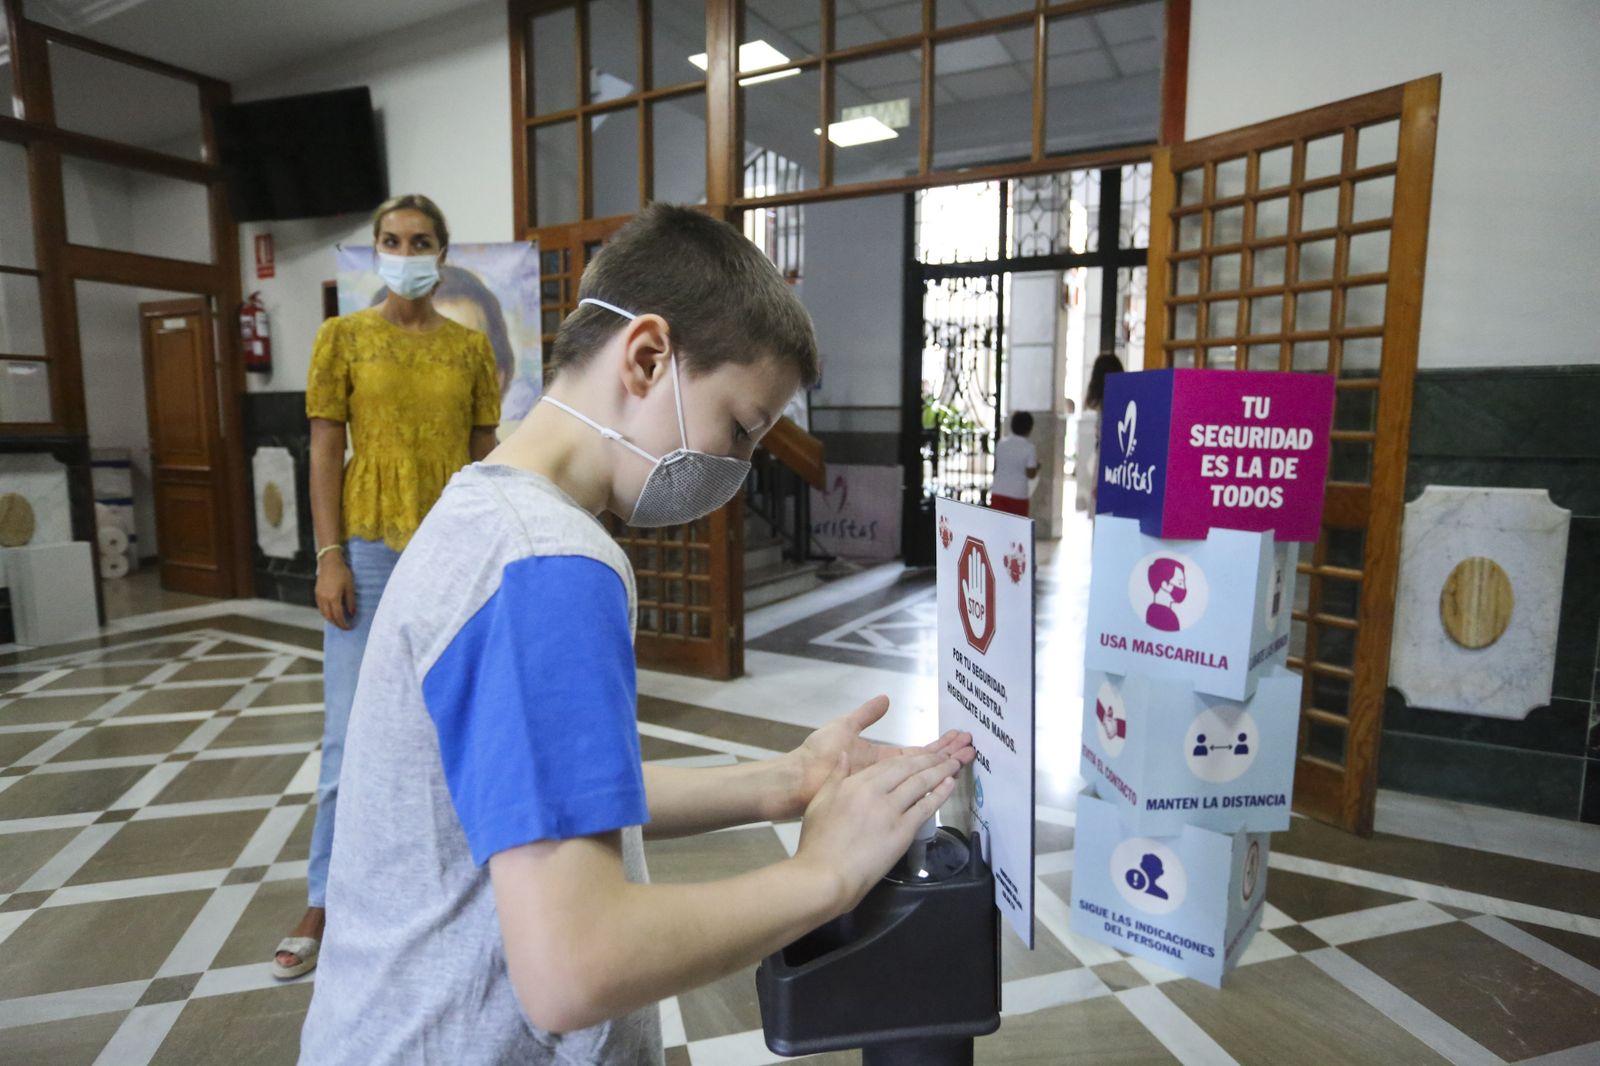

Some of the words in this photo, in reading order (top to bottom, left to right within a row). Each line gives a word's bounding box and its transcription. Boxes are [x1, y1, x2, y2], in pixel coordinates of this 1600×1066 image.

[1242, 396, 1270, 419] TU
[1189, 424, 1313, 451] SEGURIDAD
[1104, 460, 1156, 494] maristas
[1201, 454, 1229, 478] ES
[1235, 456, 1263, 479] LA
[1269, 457, 1299, 480] DE
[1210, 484, 1284, 508] TODOS
[813, 518, 878, 540] aristas
[968, 597, 985, 620] STOP
[953, 647, 963, 664] POR
[964, 656, 971, 670] TU
[1100, 633, 1127, 650] USA
[1132, 639, 1229, 670] MASCARILLA
[955, 669, 966, 687] POR
[967, 678, 974, 694] LA
[947, 681, 978, 719] HIGIENIZATE
[979, 710, 990, 730] LAS
[1105, 766, 1137, 805] CONTACTO
[1146, 797, 1199, 811] MANTEN
[1203, 797, 1219, 809] LA
[1222, 794, 1286, 809] DISTANCIA
[1079, 899, 1109, 919] SIGUE
[1112, 911, 1132, 928] LAS
[1135, 921, 1216, 958] INDICACIONES
[1104, 921, 1123, 938] DEL
[1126, 930, 1184, 960] PERSONAL
